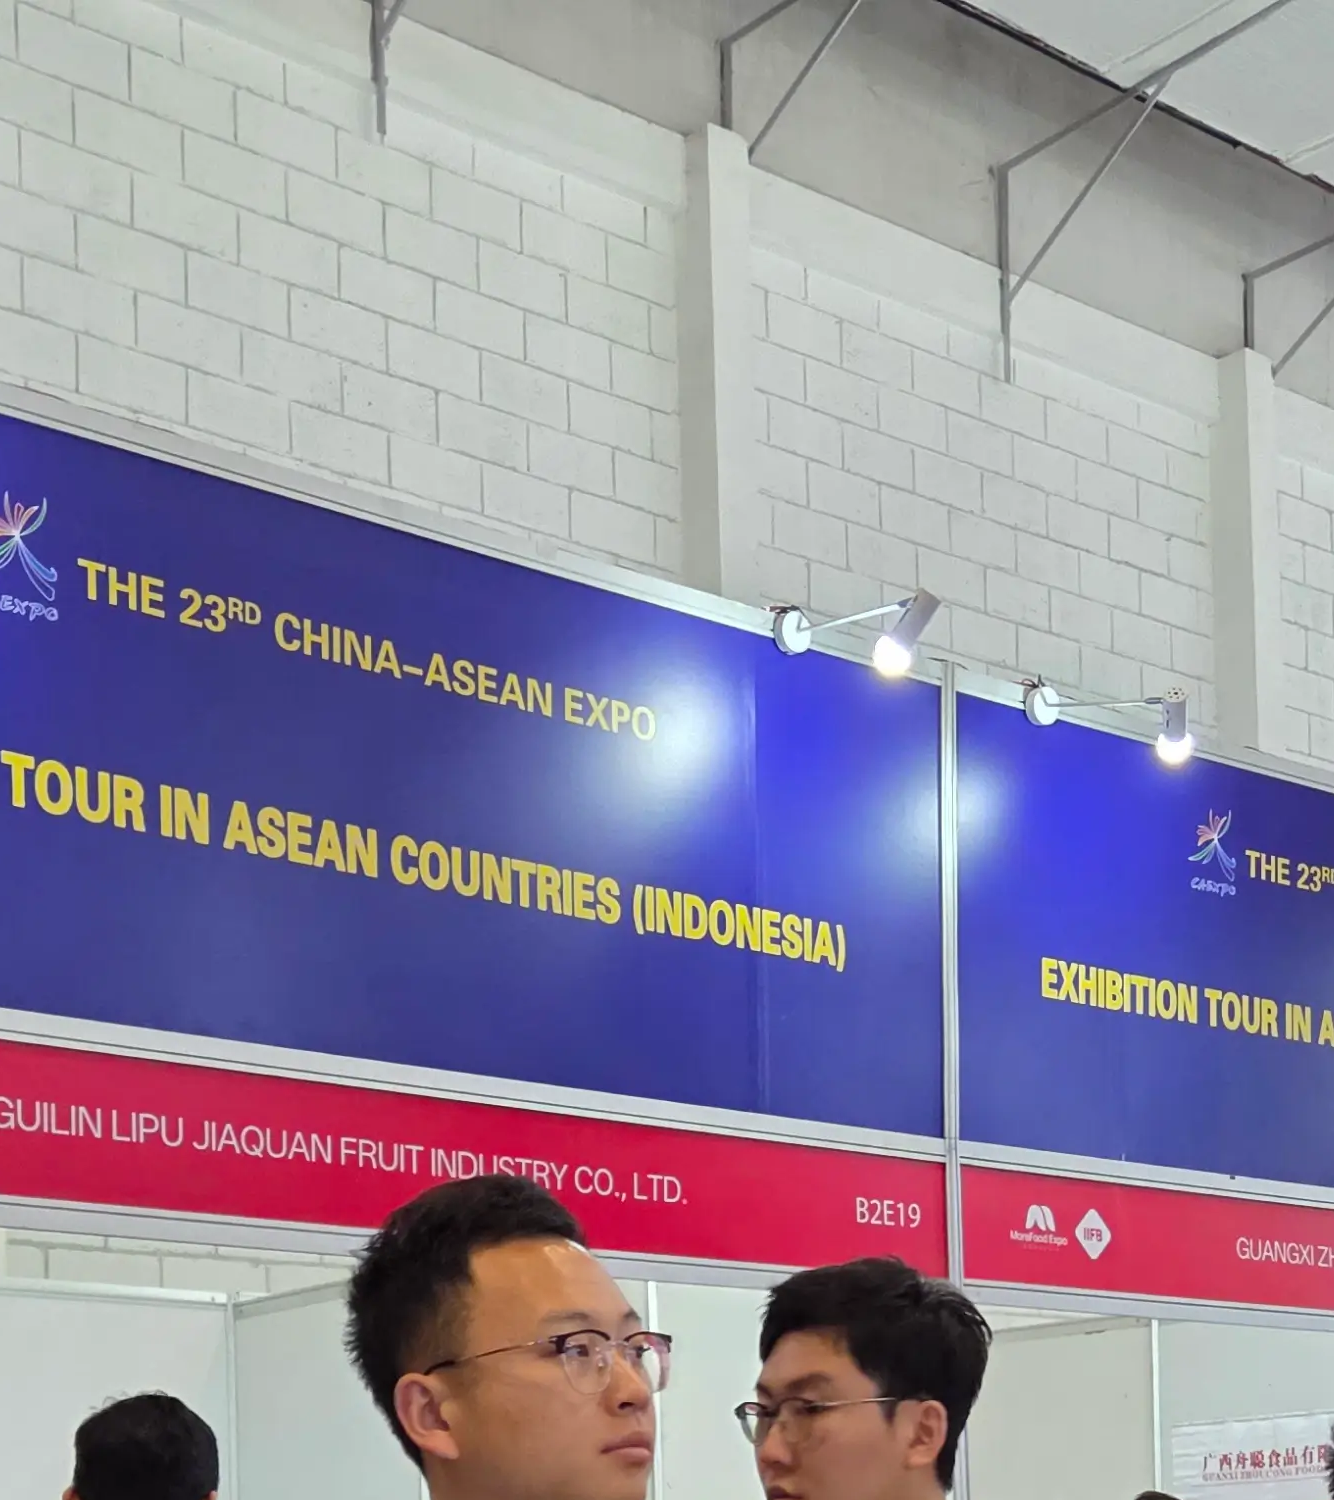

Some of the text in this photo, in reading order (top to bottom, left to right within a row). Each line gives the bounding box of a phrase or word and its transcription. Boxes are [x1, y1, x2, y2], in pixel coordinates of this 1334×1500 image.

[77, 557, 656, 742] THE 23RD CHINA-ASEAN EXPO
[0, 749, 146, 832] TOUR
[160, 785, 210, 845] IN
[223, 800, 378, 878] ASEAN
[391, 834, 621, 924] COUNTRIES
[633, 884, 846, 972] (INDONESIA)
[1245, 849, 1291, 887] THE
[1041, 957, 1198, 1025] EXHIBITION
[1204, 988, 1279, 1037] TOUR
[1285, 1003, 1312, 1043] IN
[111, 1111, 185, 1148] LIPU
[192, 1121, 333, 1165] JIAQUAN
[339, 1136, 424, 1177] FRUIT
[431, 1147, 568, 1190] INDUSTRY
[574, 1166, 627, 1202] CO.,
[633, 1172, 688, 1205] LTD.
[855, 1197, 921, 1229] B2E19
[1236, 1237, 1315, 1265] GUANGXI
